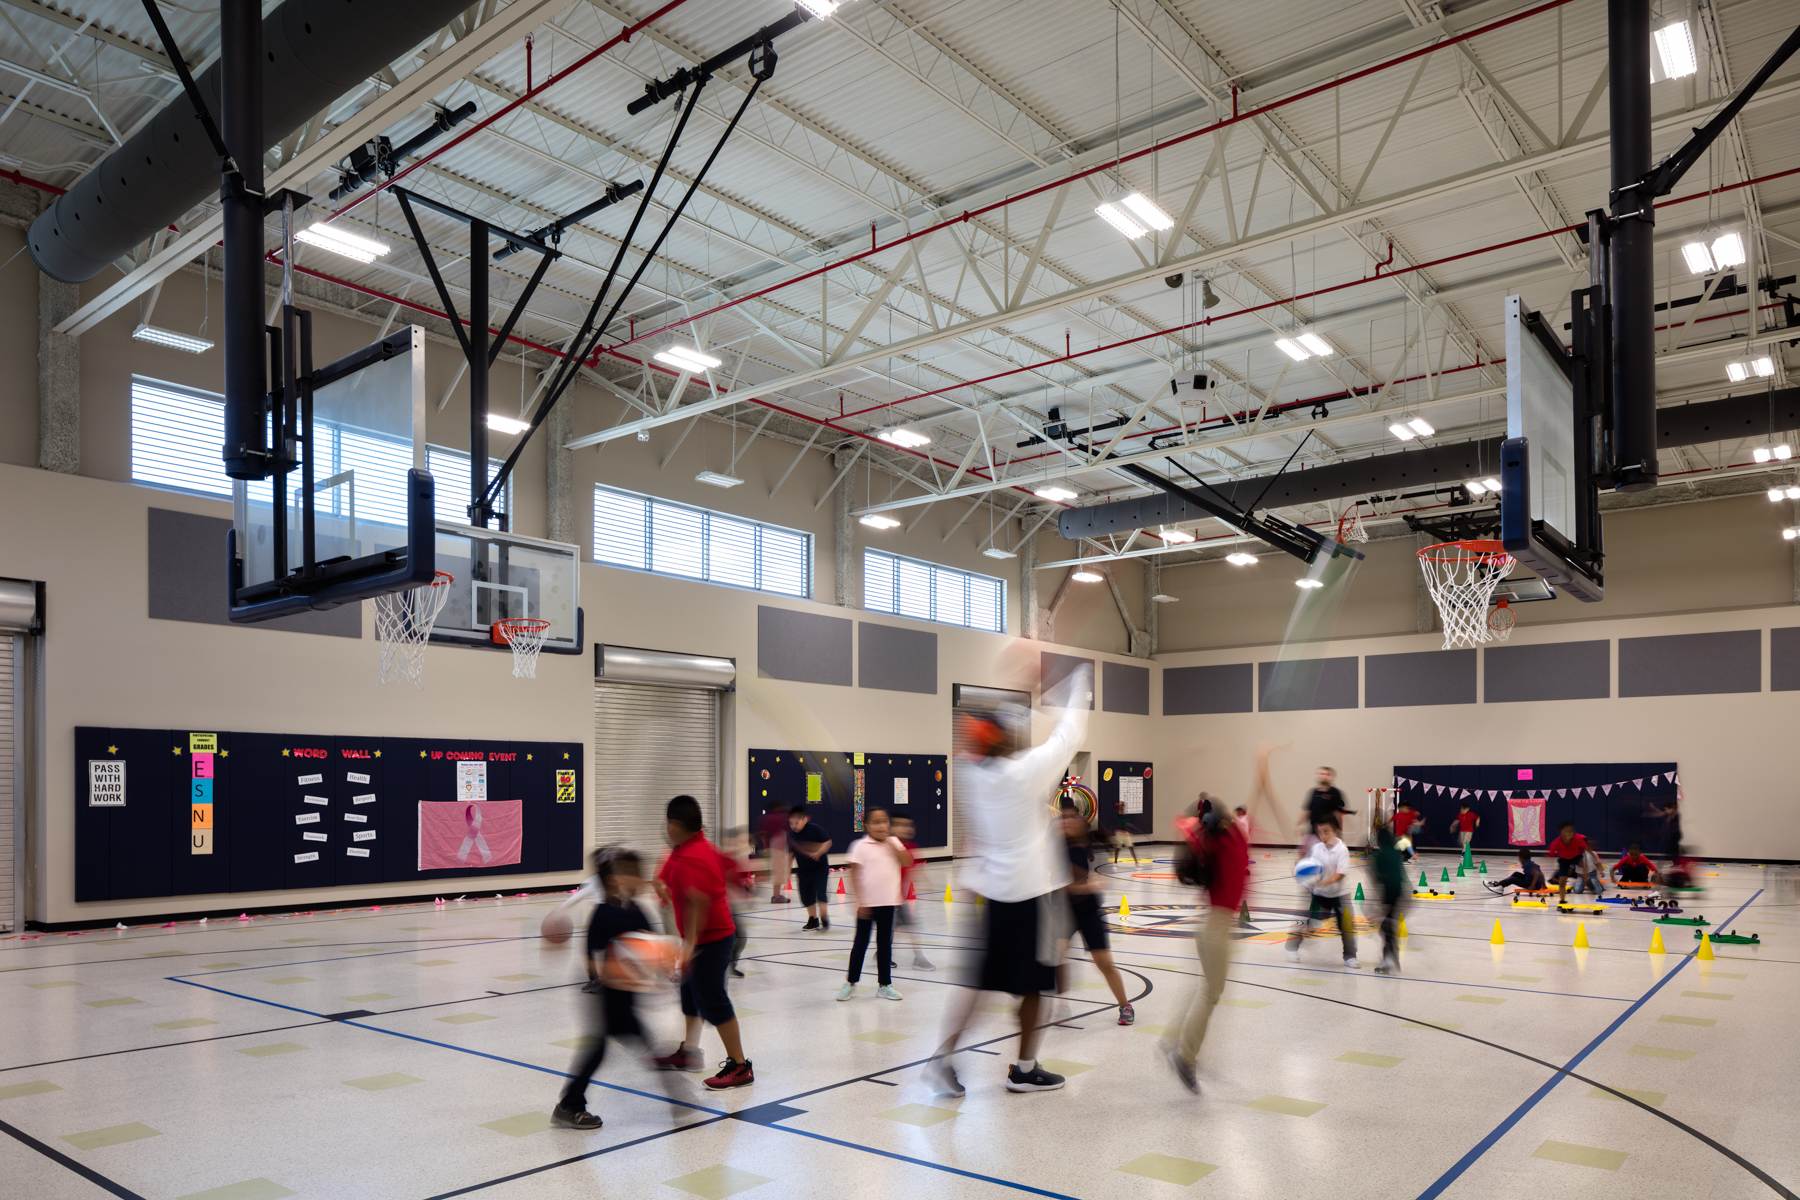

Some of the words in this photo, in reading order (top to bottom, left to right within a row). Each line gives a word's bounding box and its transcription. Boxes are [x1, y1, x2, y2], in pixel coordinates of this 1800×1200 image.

[293, 748, 328, 759] WORD
[341, 748, 371, 759] WALL
[430, 751, 443, 760] UP
[446, 751, 484, 761] COMING
[488, 752, 517, 761] EVENT
[94, 764, 120, 773] PASS
[195, 761, 205, 778] E
[94, 774, 120, 783] WITH
[94, 784, 121, 792] HARD
[195, 784, 204, 798] S
[93, 793, 122, 802] WORK
[193, 809, 204, 823] N
[193, 834, 204, 848] U
